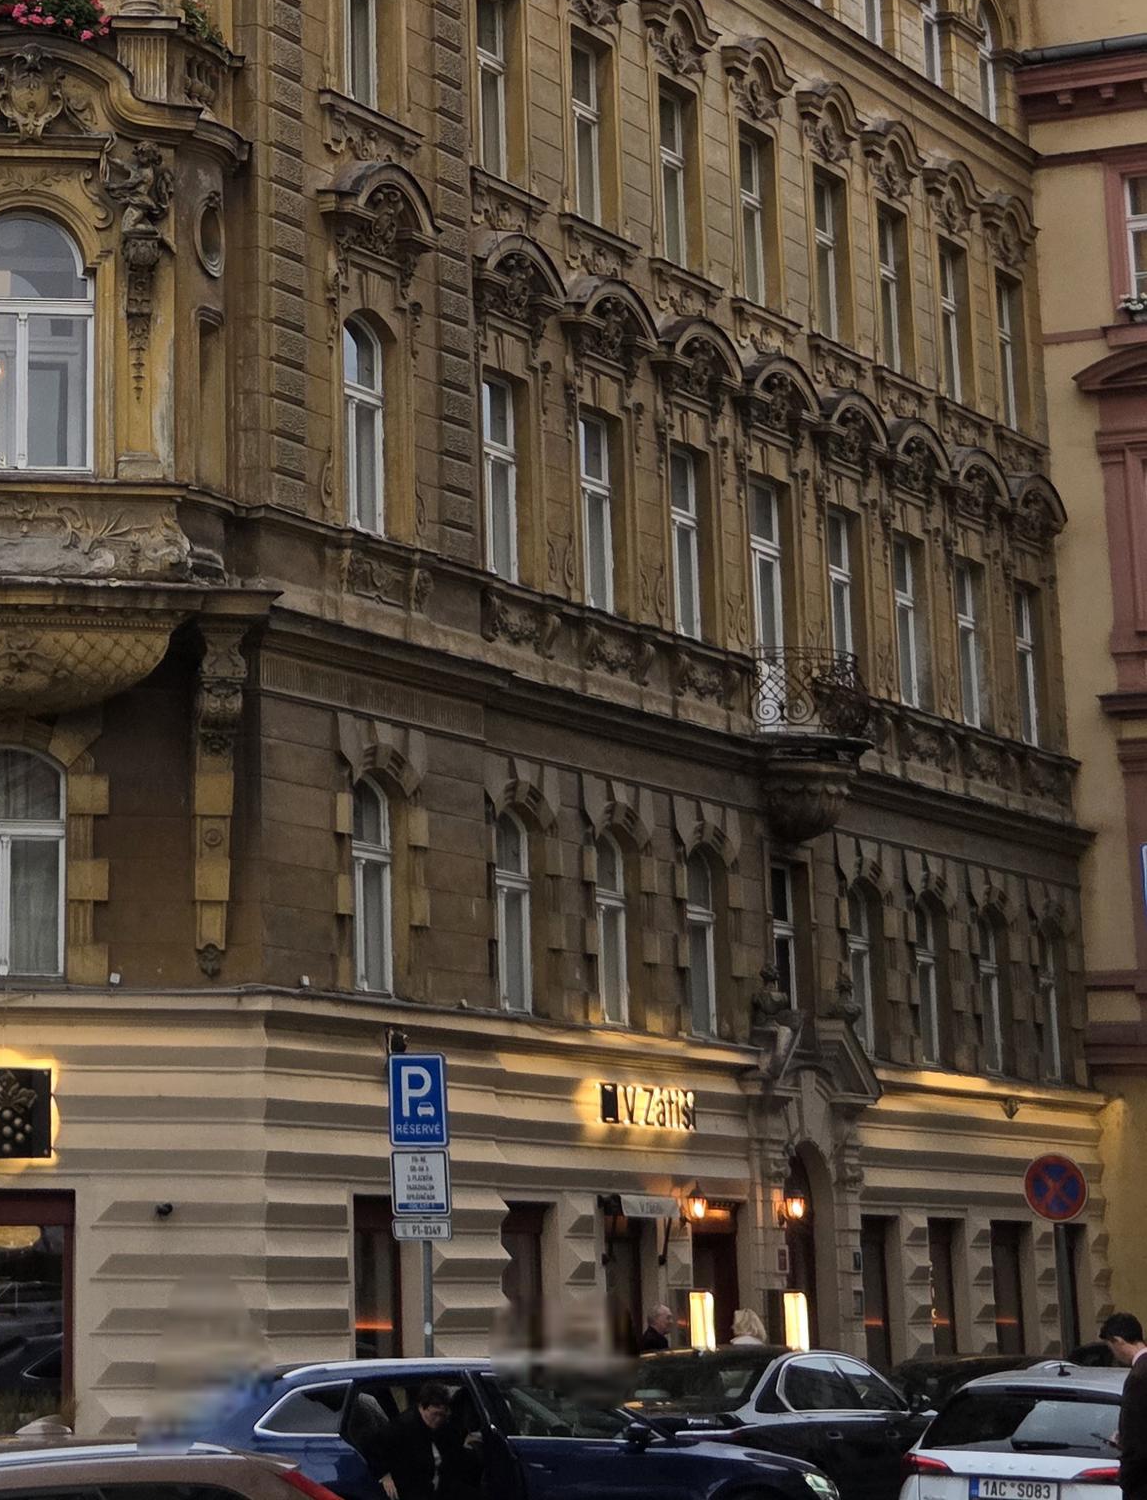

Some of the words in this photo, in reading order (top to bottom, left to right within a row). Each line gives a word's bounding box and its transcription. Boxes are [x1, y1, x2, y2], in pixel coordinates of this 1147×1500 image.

[401, 1066, 432, 1117] P
[623, 1086, 636, 1124] V
[396, 1121, 442, 1135] RÉSERVÉ
[983, 1481, 1007, 1496] 1AC
